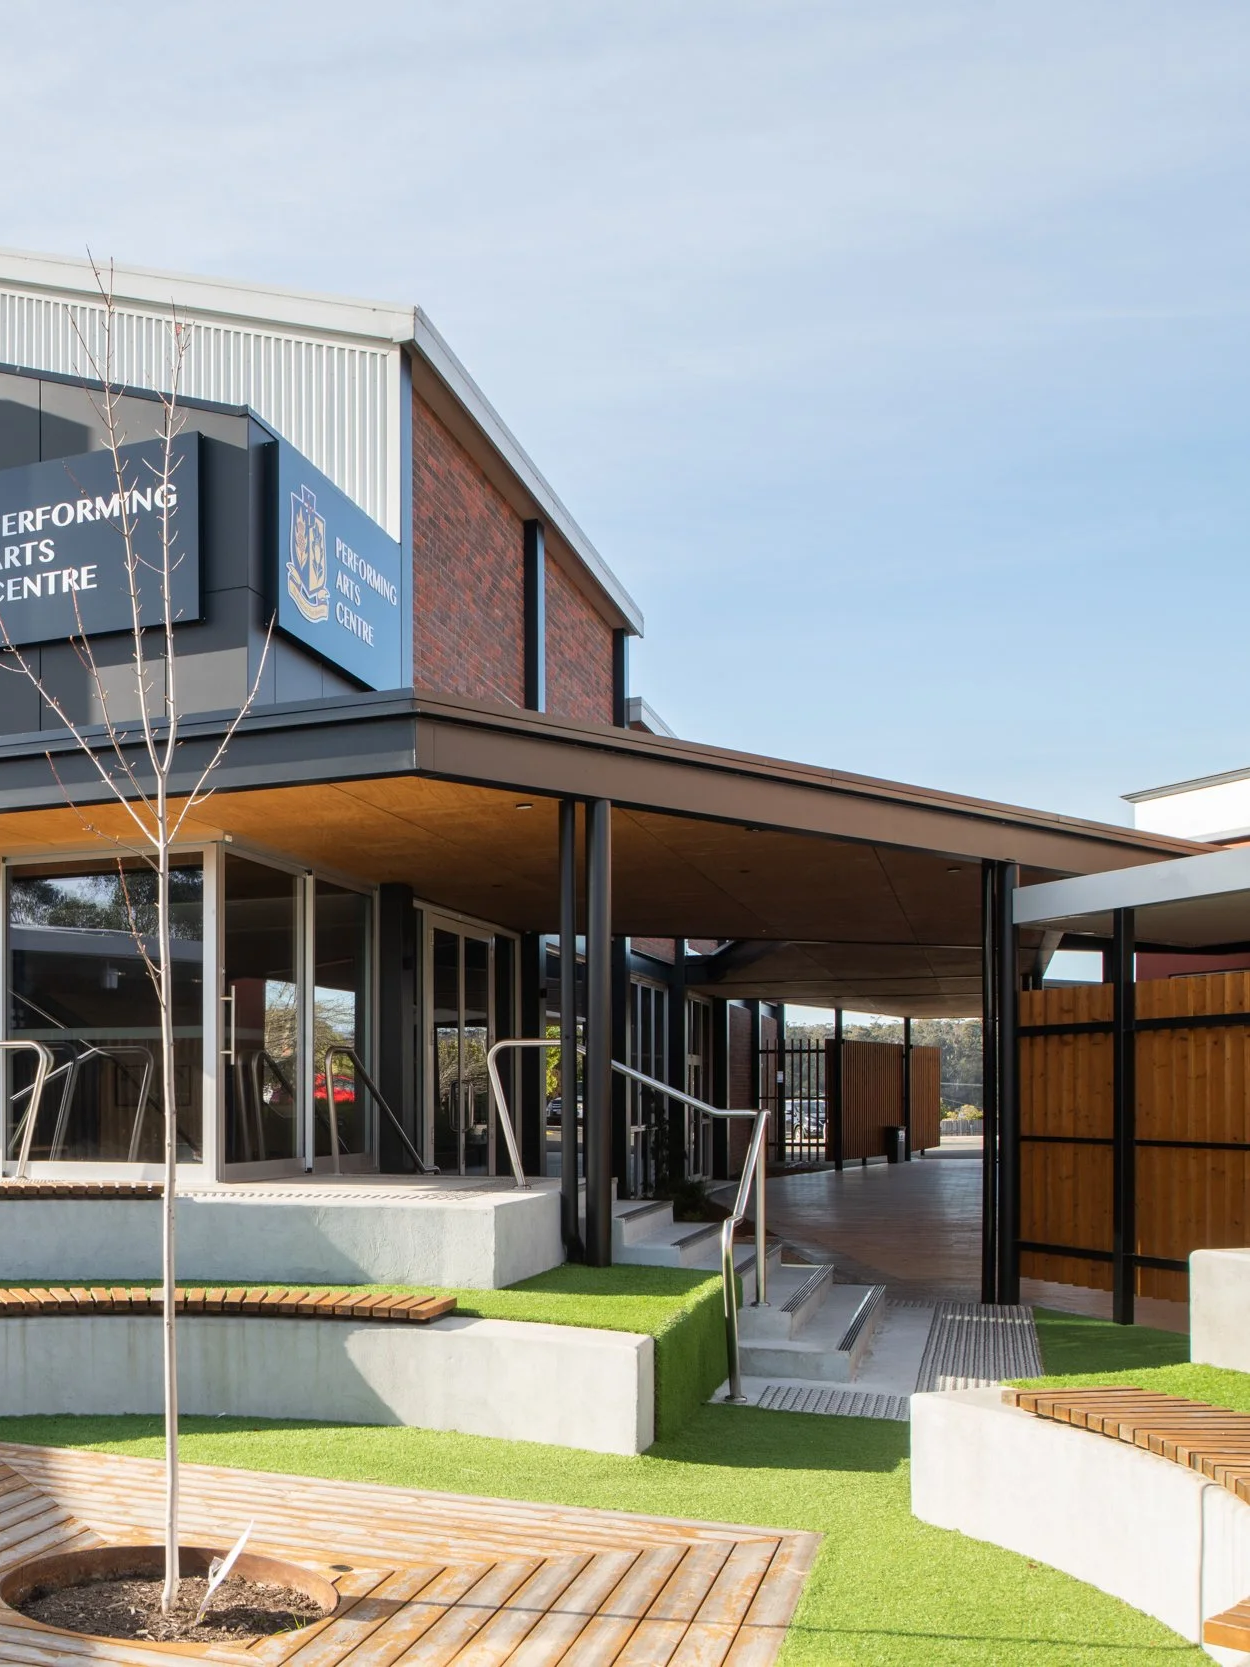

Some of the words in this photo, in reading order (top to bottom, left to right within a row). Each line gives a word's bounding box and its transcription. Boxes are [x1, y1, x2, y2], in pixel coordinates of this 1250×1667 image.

[335, 536, 397, 606] PERFORMING
[335, 570, 361, 607] ARTS
[335, 601, 375, 648] CENTRE
